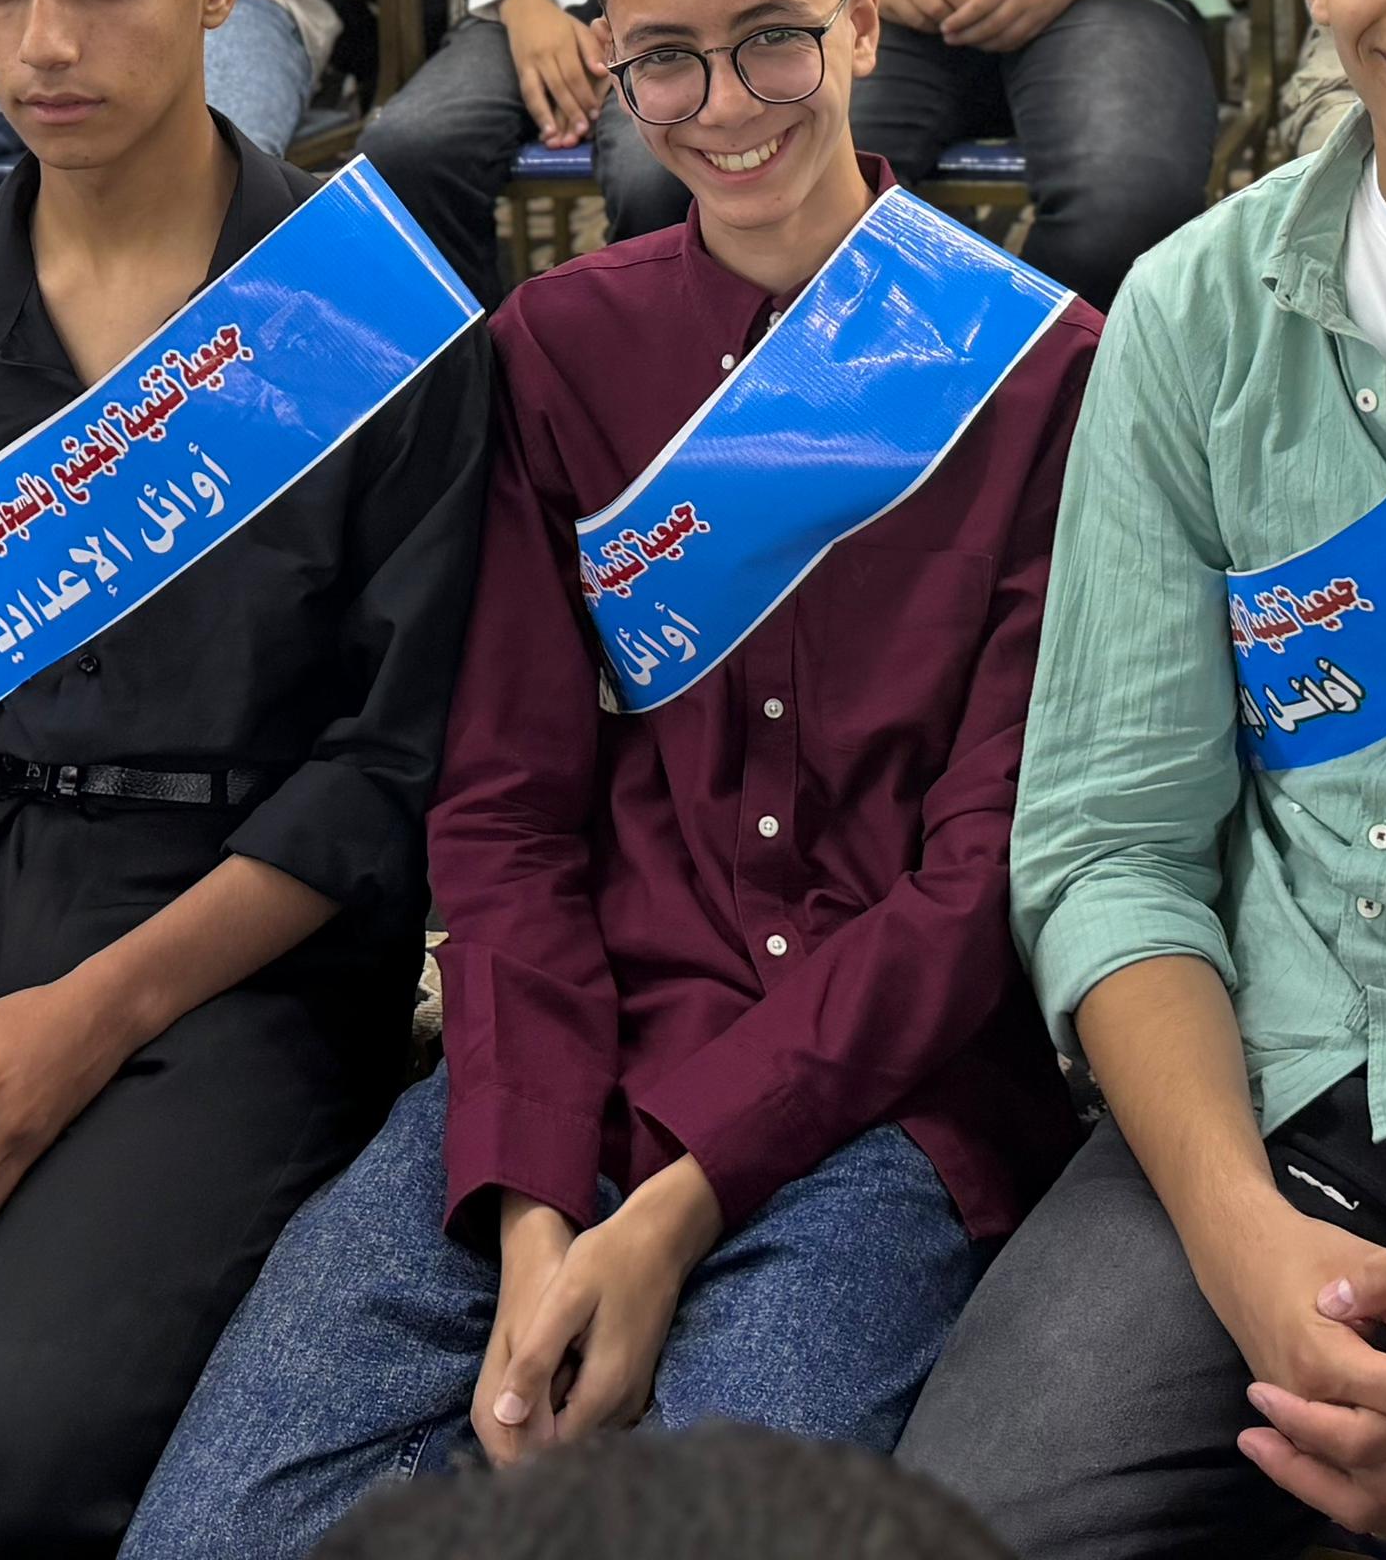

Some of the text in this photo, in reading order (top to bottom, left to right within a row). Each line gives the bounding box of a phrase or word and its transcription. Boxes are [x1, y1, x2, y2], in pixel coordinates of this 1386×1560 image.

[162, 323, 253, 390] جمعية
[103, 366, 188, 441] تنمية
[52, 418, 129, 504] المجتمع
[139, 442, 231, 555] أوائل
[618, 501, 710, 561] جمعية
[1273, 577, 1375, 631] جمعية
[616, 601, 701, 686] أوائل
[1264, 657, 1366, 734] أوائل
